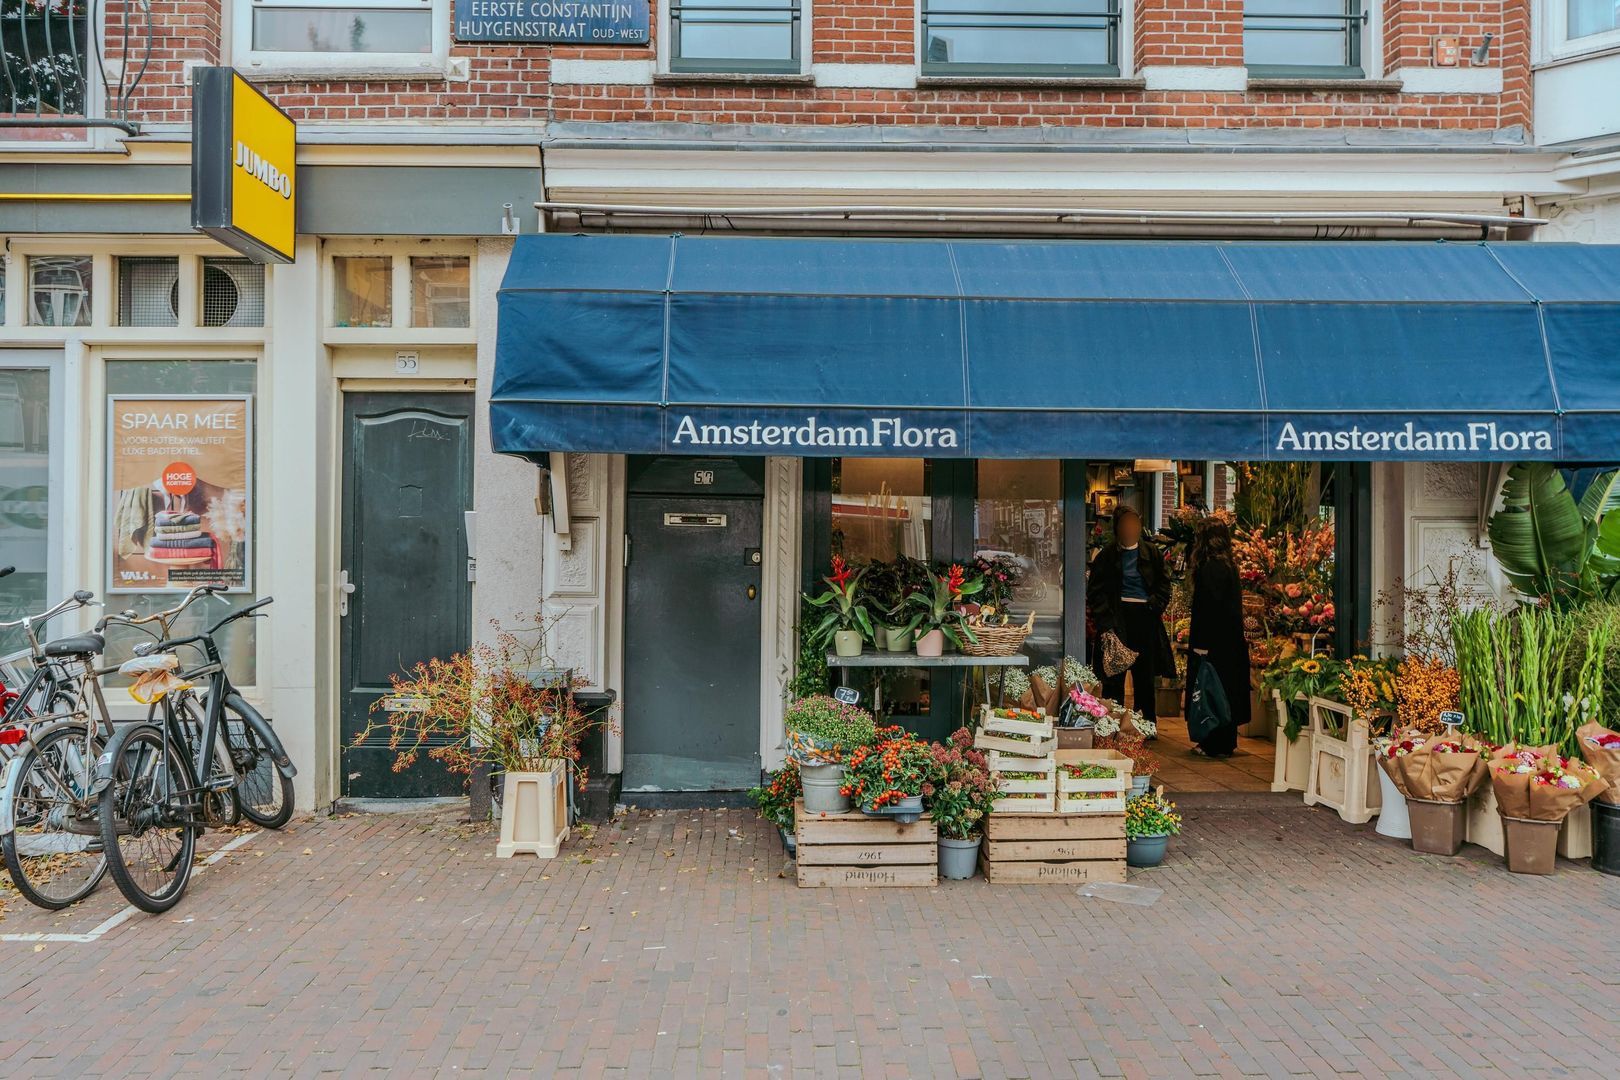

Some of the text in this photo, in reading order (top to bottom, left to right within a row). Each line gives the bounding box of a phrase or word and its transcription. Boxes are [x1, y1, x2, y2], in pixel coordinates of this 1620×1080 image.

[472, 2, 632, 23] EERSTE CONSTANTIJN
[459, 20, 645, 39] HUYGENSSTRAAT OUD-WEST
[235, 140, 291, 200] JUMBO
[398, 355, 417, 369] 55
[121, 413, 238, 429] SPAAR MEE
[672, 415, 958, 448] AmsterdamFlora
[1275, 421, 1553, 451] AmsterdamFlora
[122, 436, 226, 445] VOOR HOTELKWALITEIT
[122, 447, 202, 456] LUXE BADTEXTIEL
[166, 472, 193, 481] HOGE
[695, 471, 713, 484] 57
[858, 851, 882, 860] 1967
[845, 871, 896, 883] Holland
[1039, 867, 1088, 878] Holland
